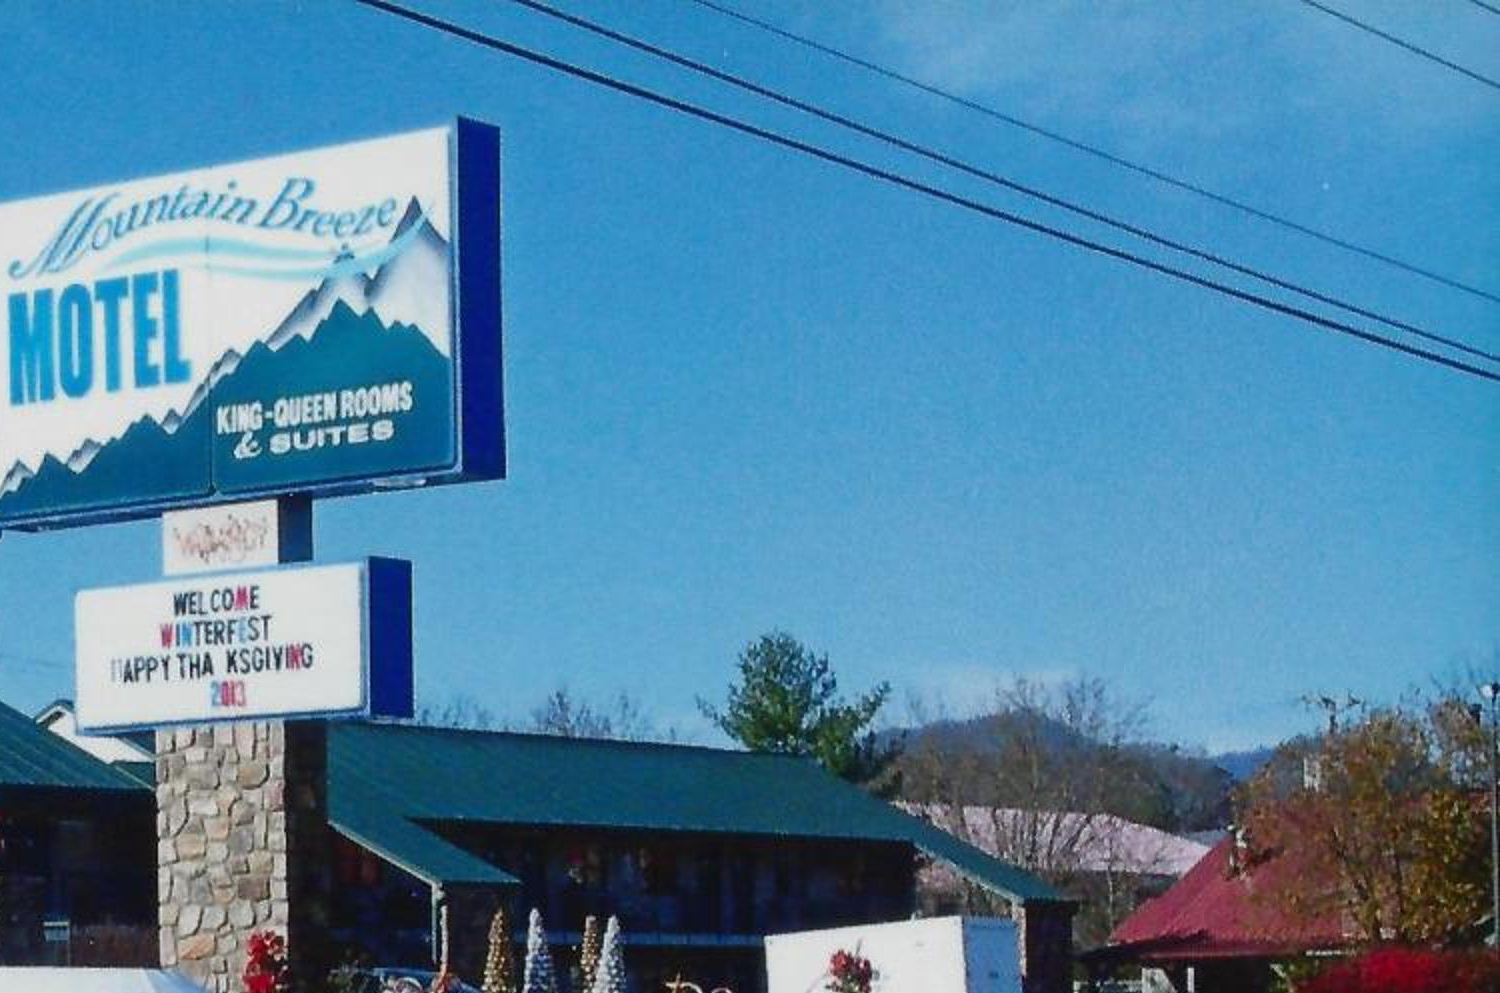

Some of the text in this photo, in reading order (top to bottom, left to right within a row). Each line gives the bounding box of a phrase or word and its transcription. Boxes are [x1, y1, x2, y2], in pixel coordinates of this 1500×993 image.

[8, 175, 398, 280] Mountain Breeze
[8, 269, 192, 406] MOTEL
[217, 380, 414, 435] KING-QUEEN ROOMS
[233, 419, 395, 460] & SUITES
[173, 585, 260, 616] WELCOME
[160, 614, 273, 650] WINTERFEST
[210, 680, 247, 707] 2013
